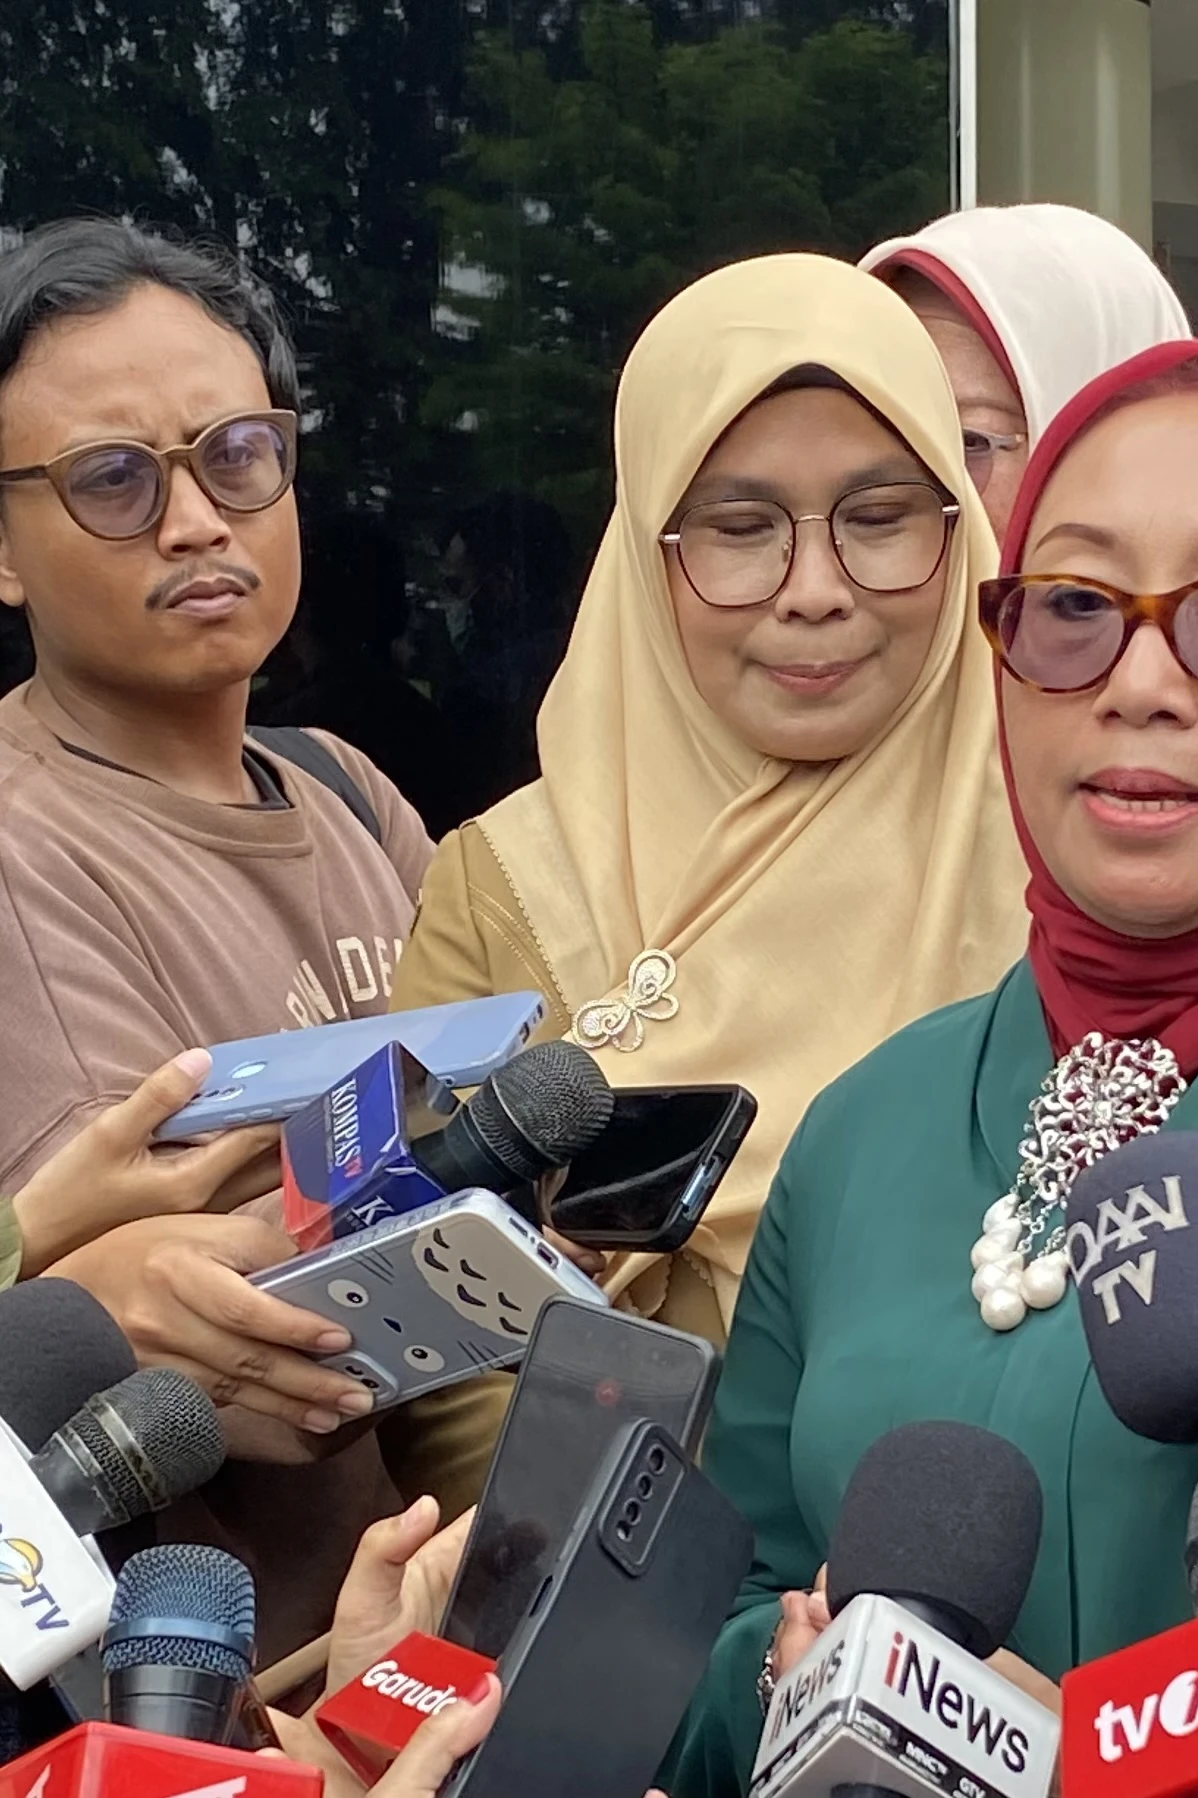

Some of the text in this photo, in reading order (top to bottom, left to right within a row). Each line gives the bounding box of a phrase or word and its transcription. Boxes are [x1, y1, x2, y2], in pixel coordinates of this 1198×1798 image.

[331, 1077, 362, 1168] KOMPAS
[1091, 1249, 1157, 1326] TV
[20, 1582, 70, 1631] TV
[769, 1640, 845, 1746] iNews
[884, 1631, 1029, 1774] iNews
